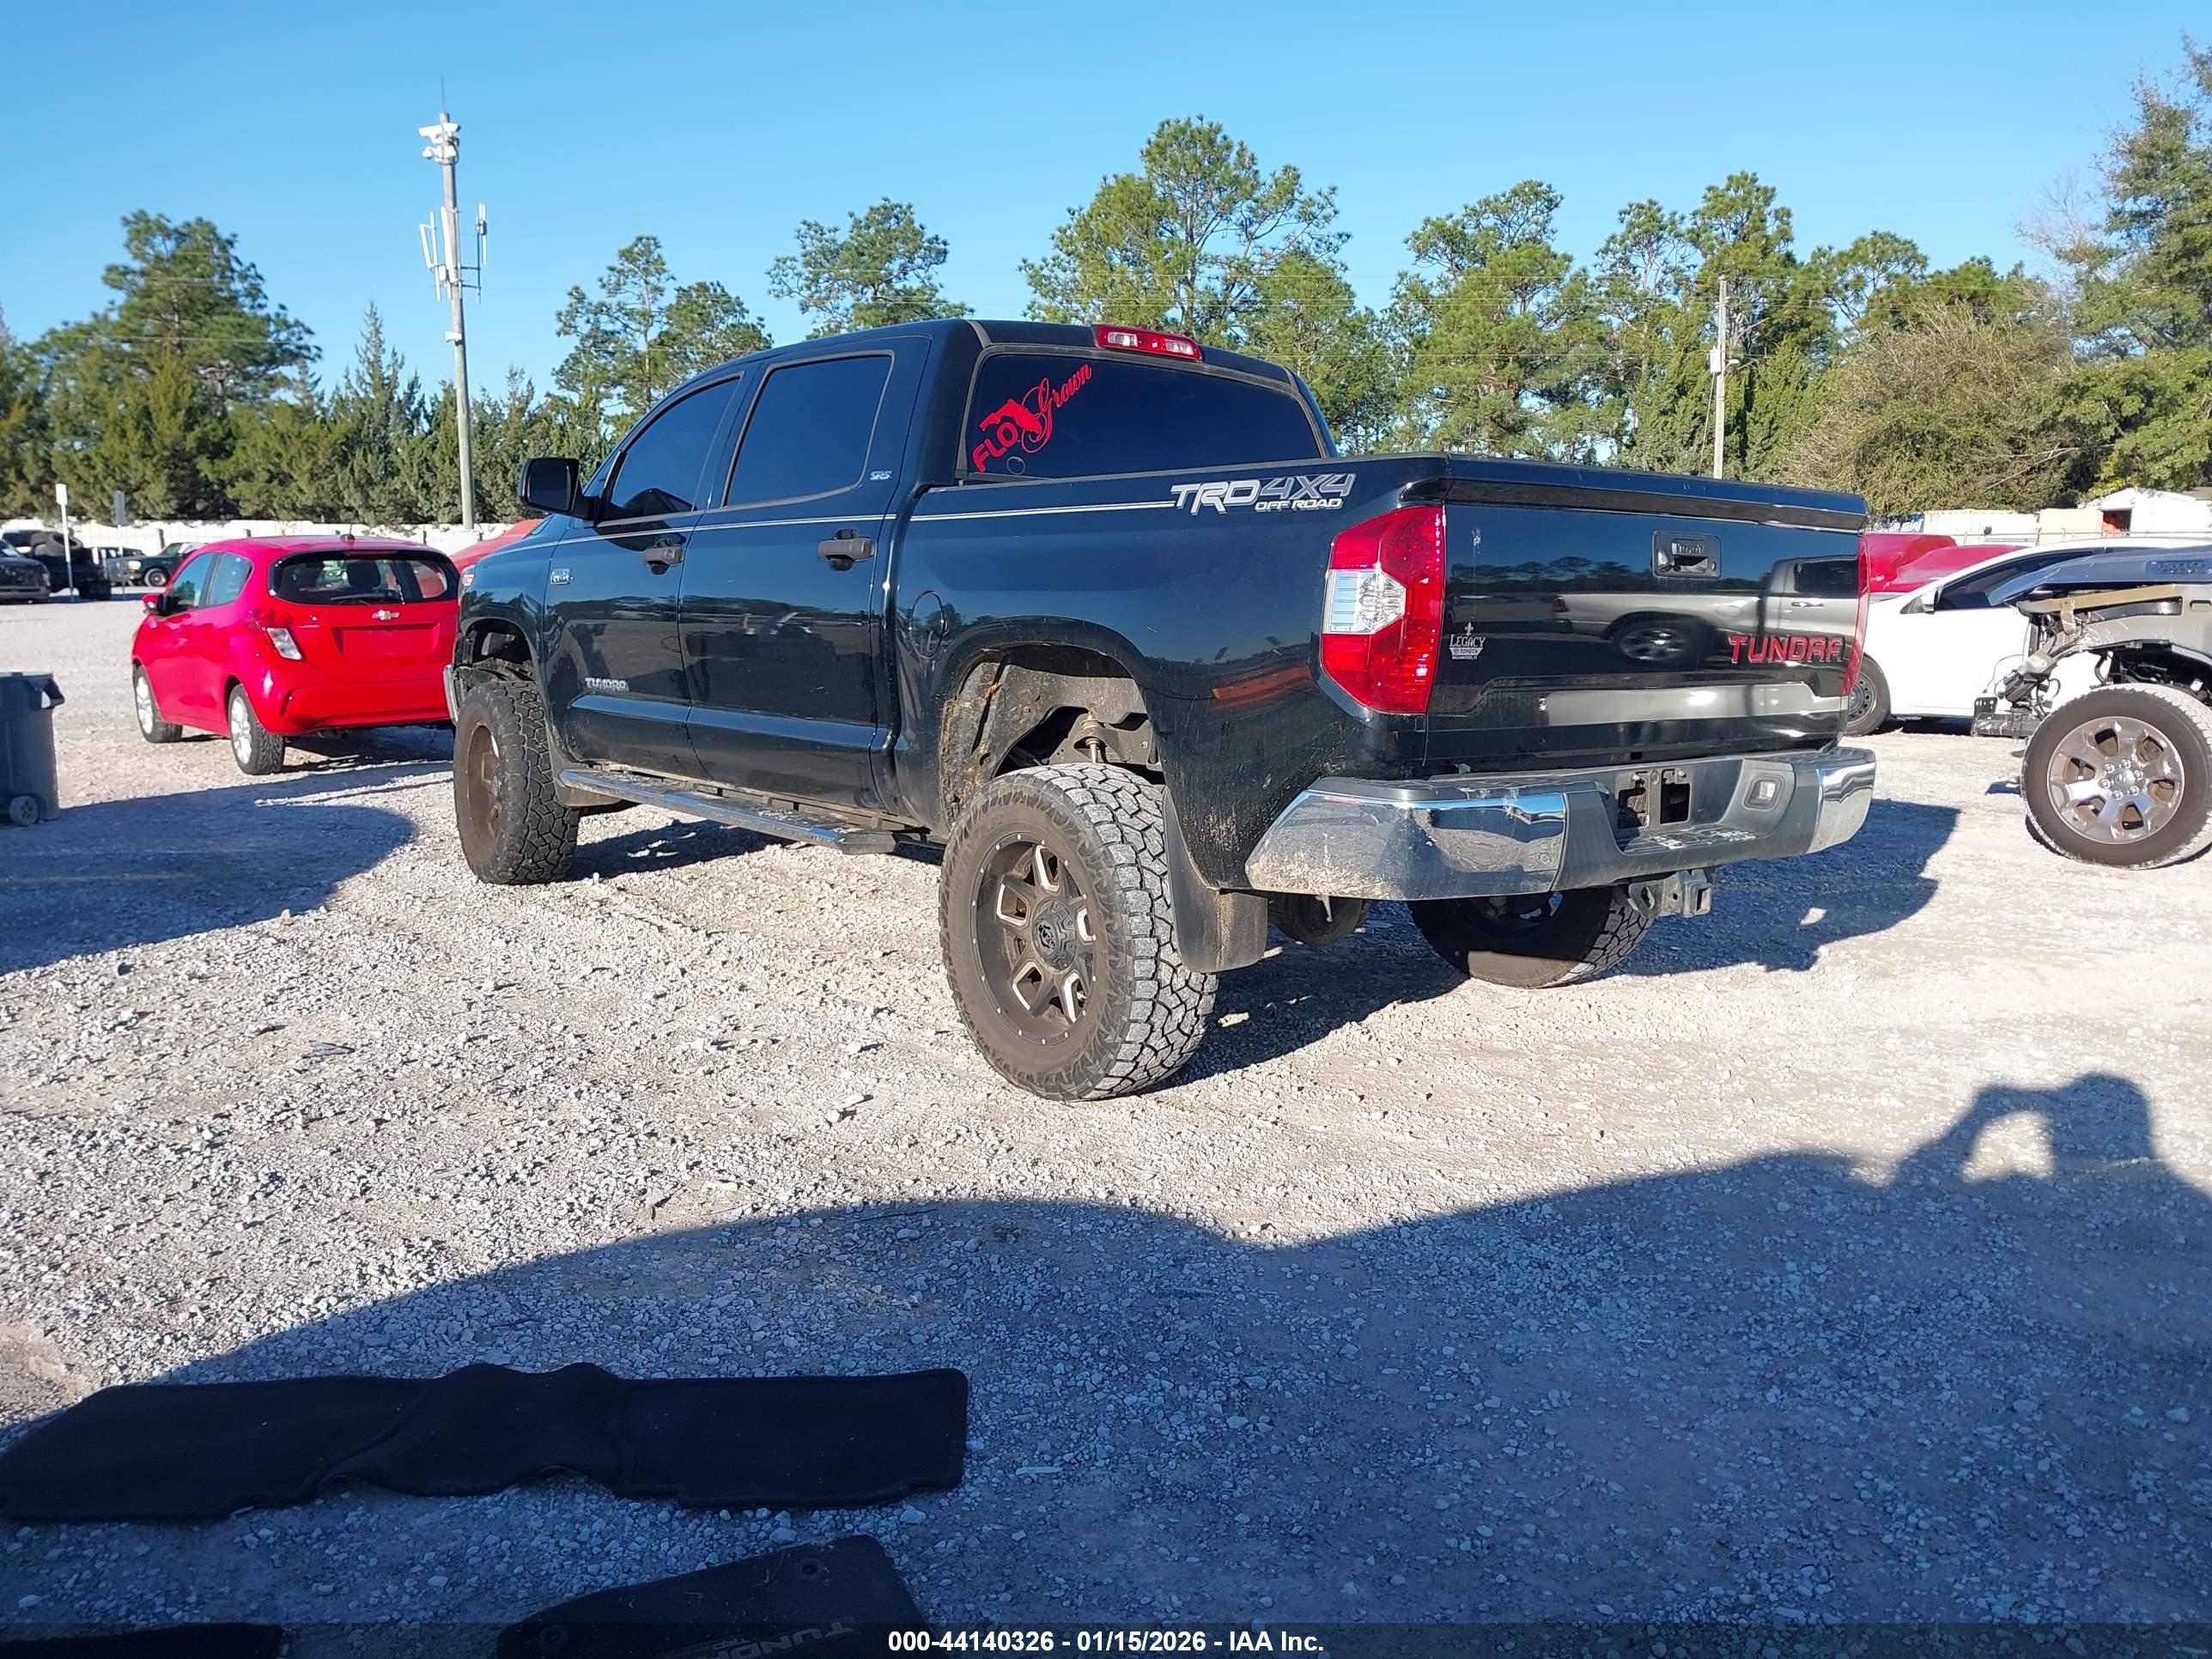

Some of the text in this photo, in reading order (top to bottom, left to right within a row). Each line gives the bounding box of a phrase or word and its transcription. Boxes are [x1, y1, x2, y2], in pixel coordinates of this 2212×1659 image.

[1021, 363, 1092, 453] Grown
[973, 422, 1018, 472] FLO
[1255, 497, 1344, 513] OFF ROAD
[585, 677, 629, 692] TUNDRA
